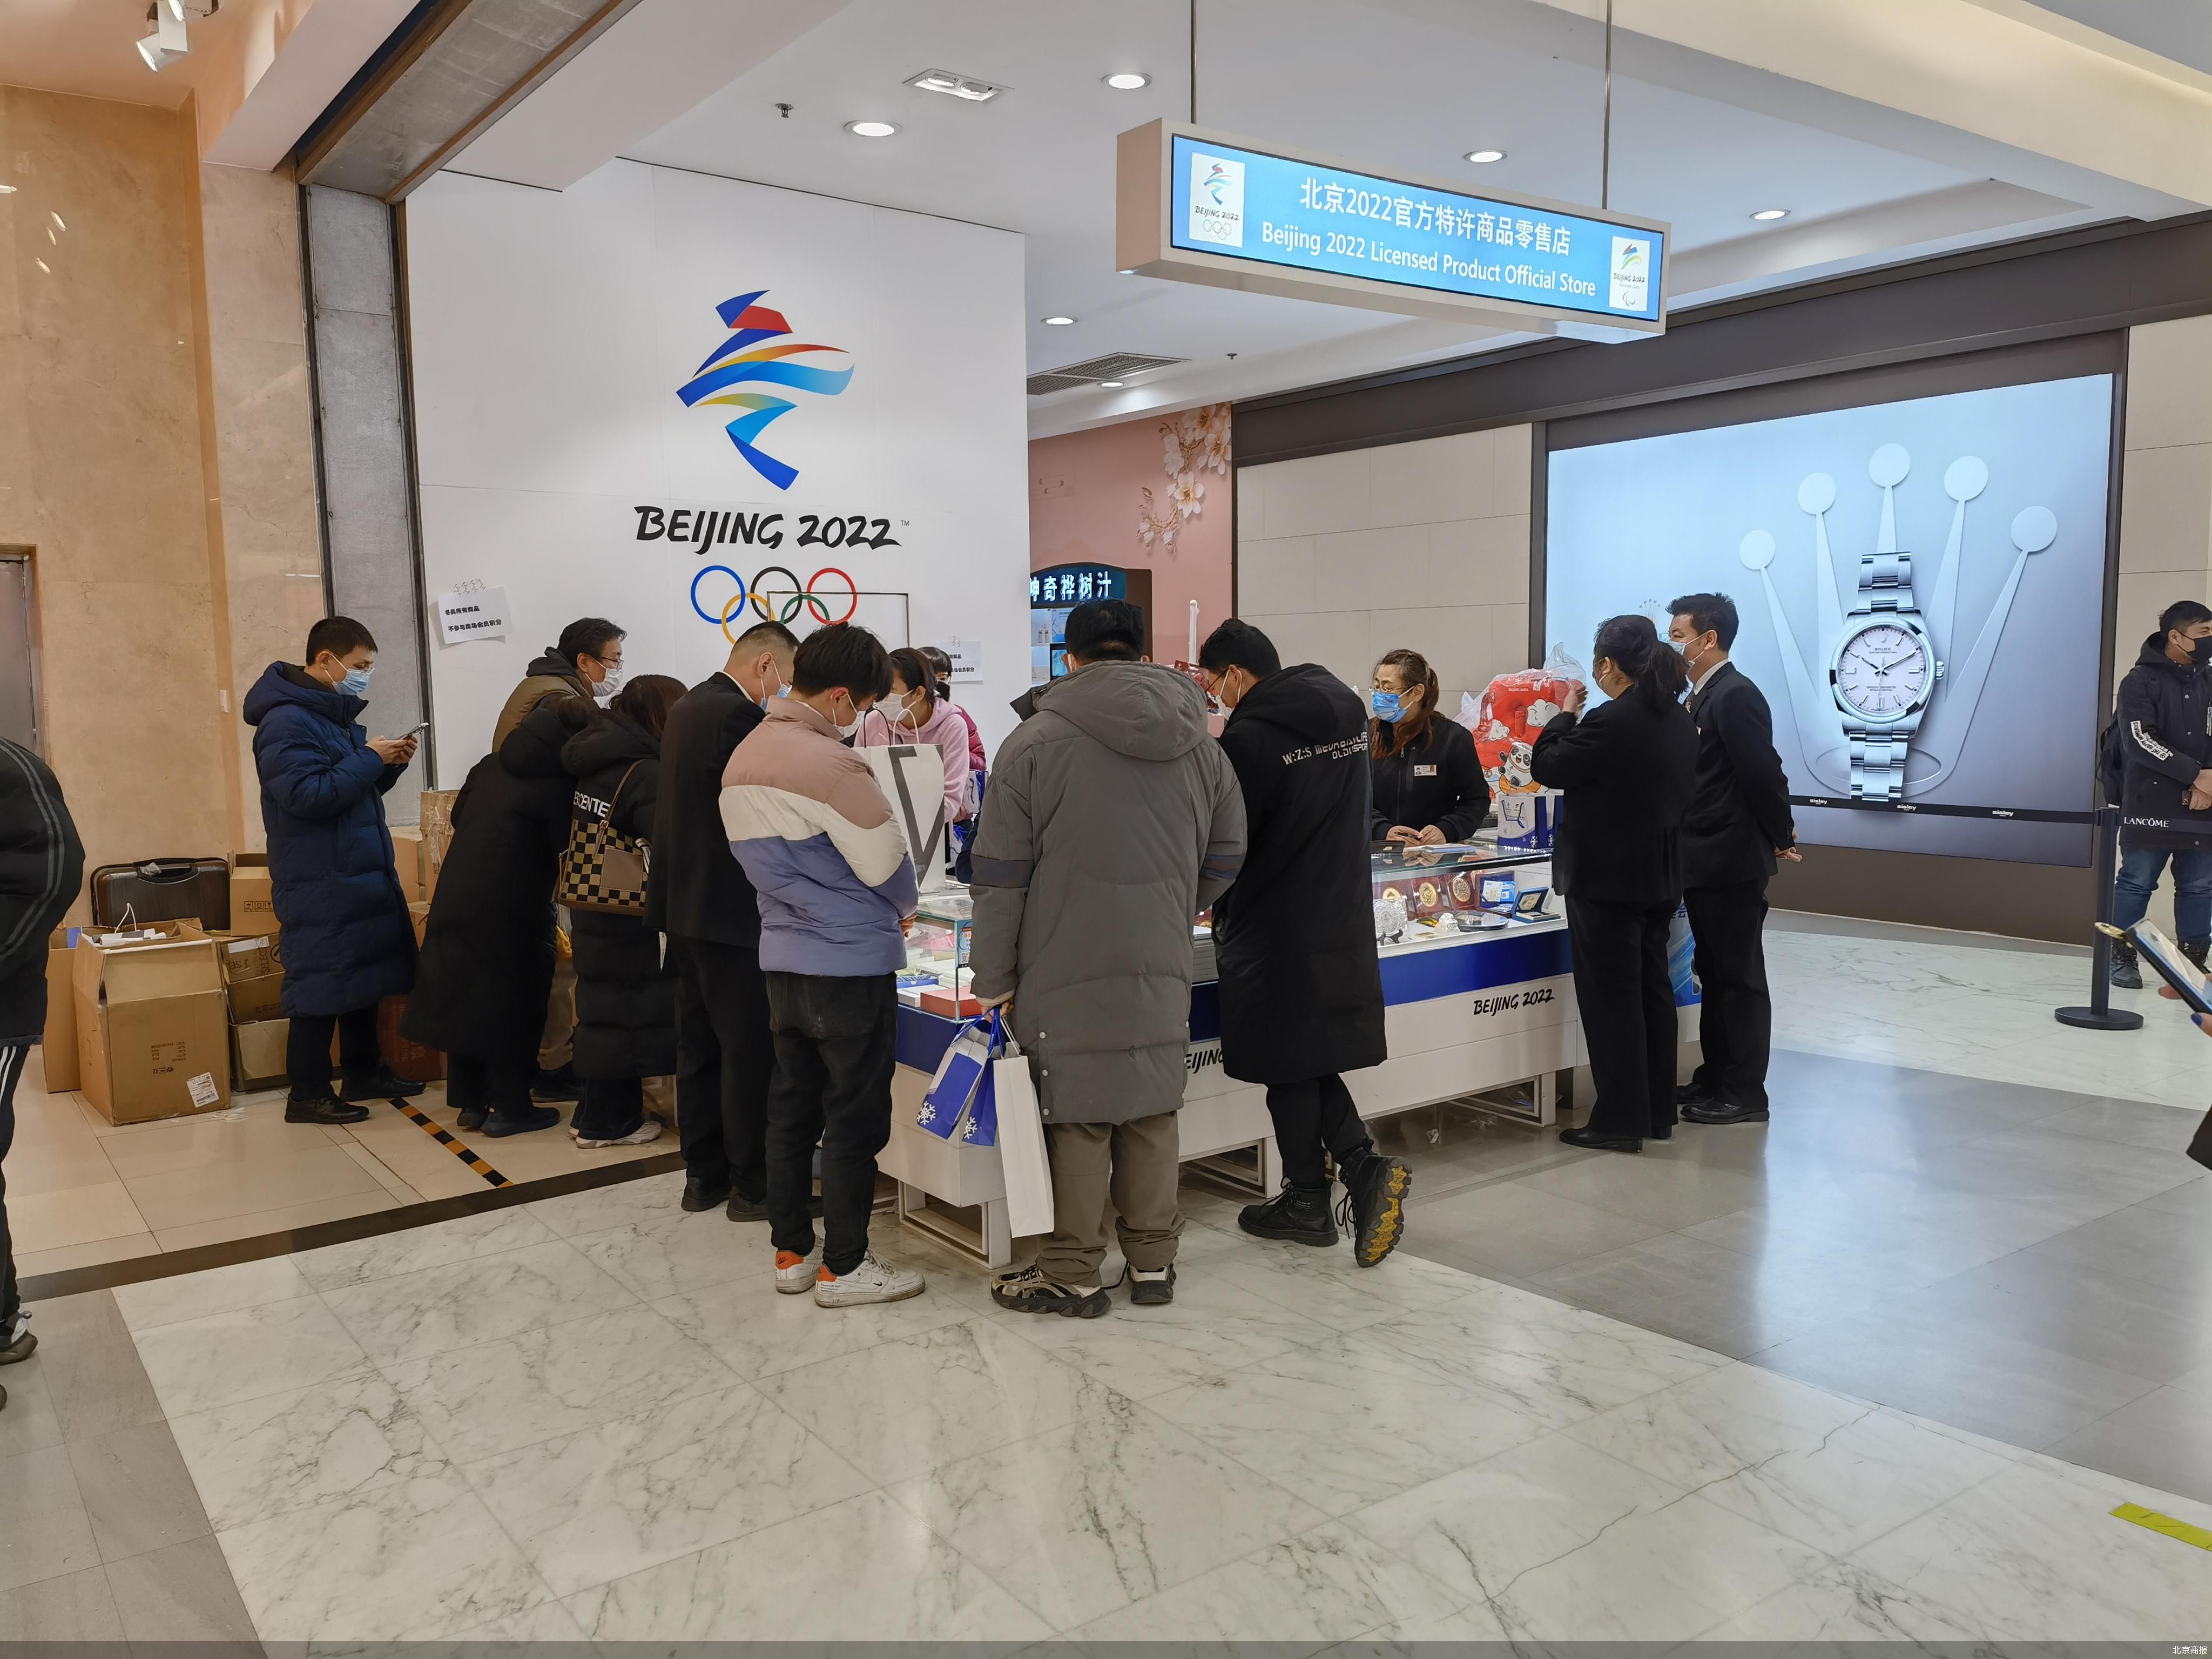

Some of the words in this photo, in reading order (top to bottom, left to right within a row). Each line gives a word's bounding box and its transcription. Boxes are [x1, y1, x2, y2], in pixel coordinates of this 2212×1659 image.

[1195, 206, 1219, 218] BEIJING
[1222, 212, 1240, 221] 2022
[1300, 177, 1572, 257] 北京2022官方特许商品零售店
[1262, 221, 1321, 257] Beijing
[1326, 234, 1367, 258] 2022
[1371, 241, 1439, 271] Licensed
[1442, 254, 1500, 281] Product
[1504, 262, 1556, 290] Official
[1560, 273, 1596, 296] Store
[634, 505, 784, 555] BEIJING
[797, 515, 902, 550] 2022
[2123, 817, 2170, 828] LANCÔME
[1473, 994, 1519, 1017] BEIJING
[1522, 988, 1555, 1007] 2022
